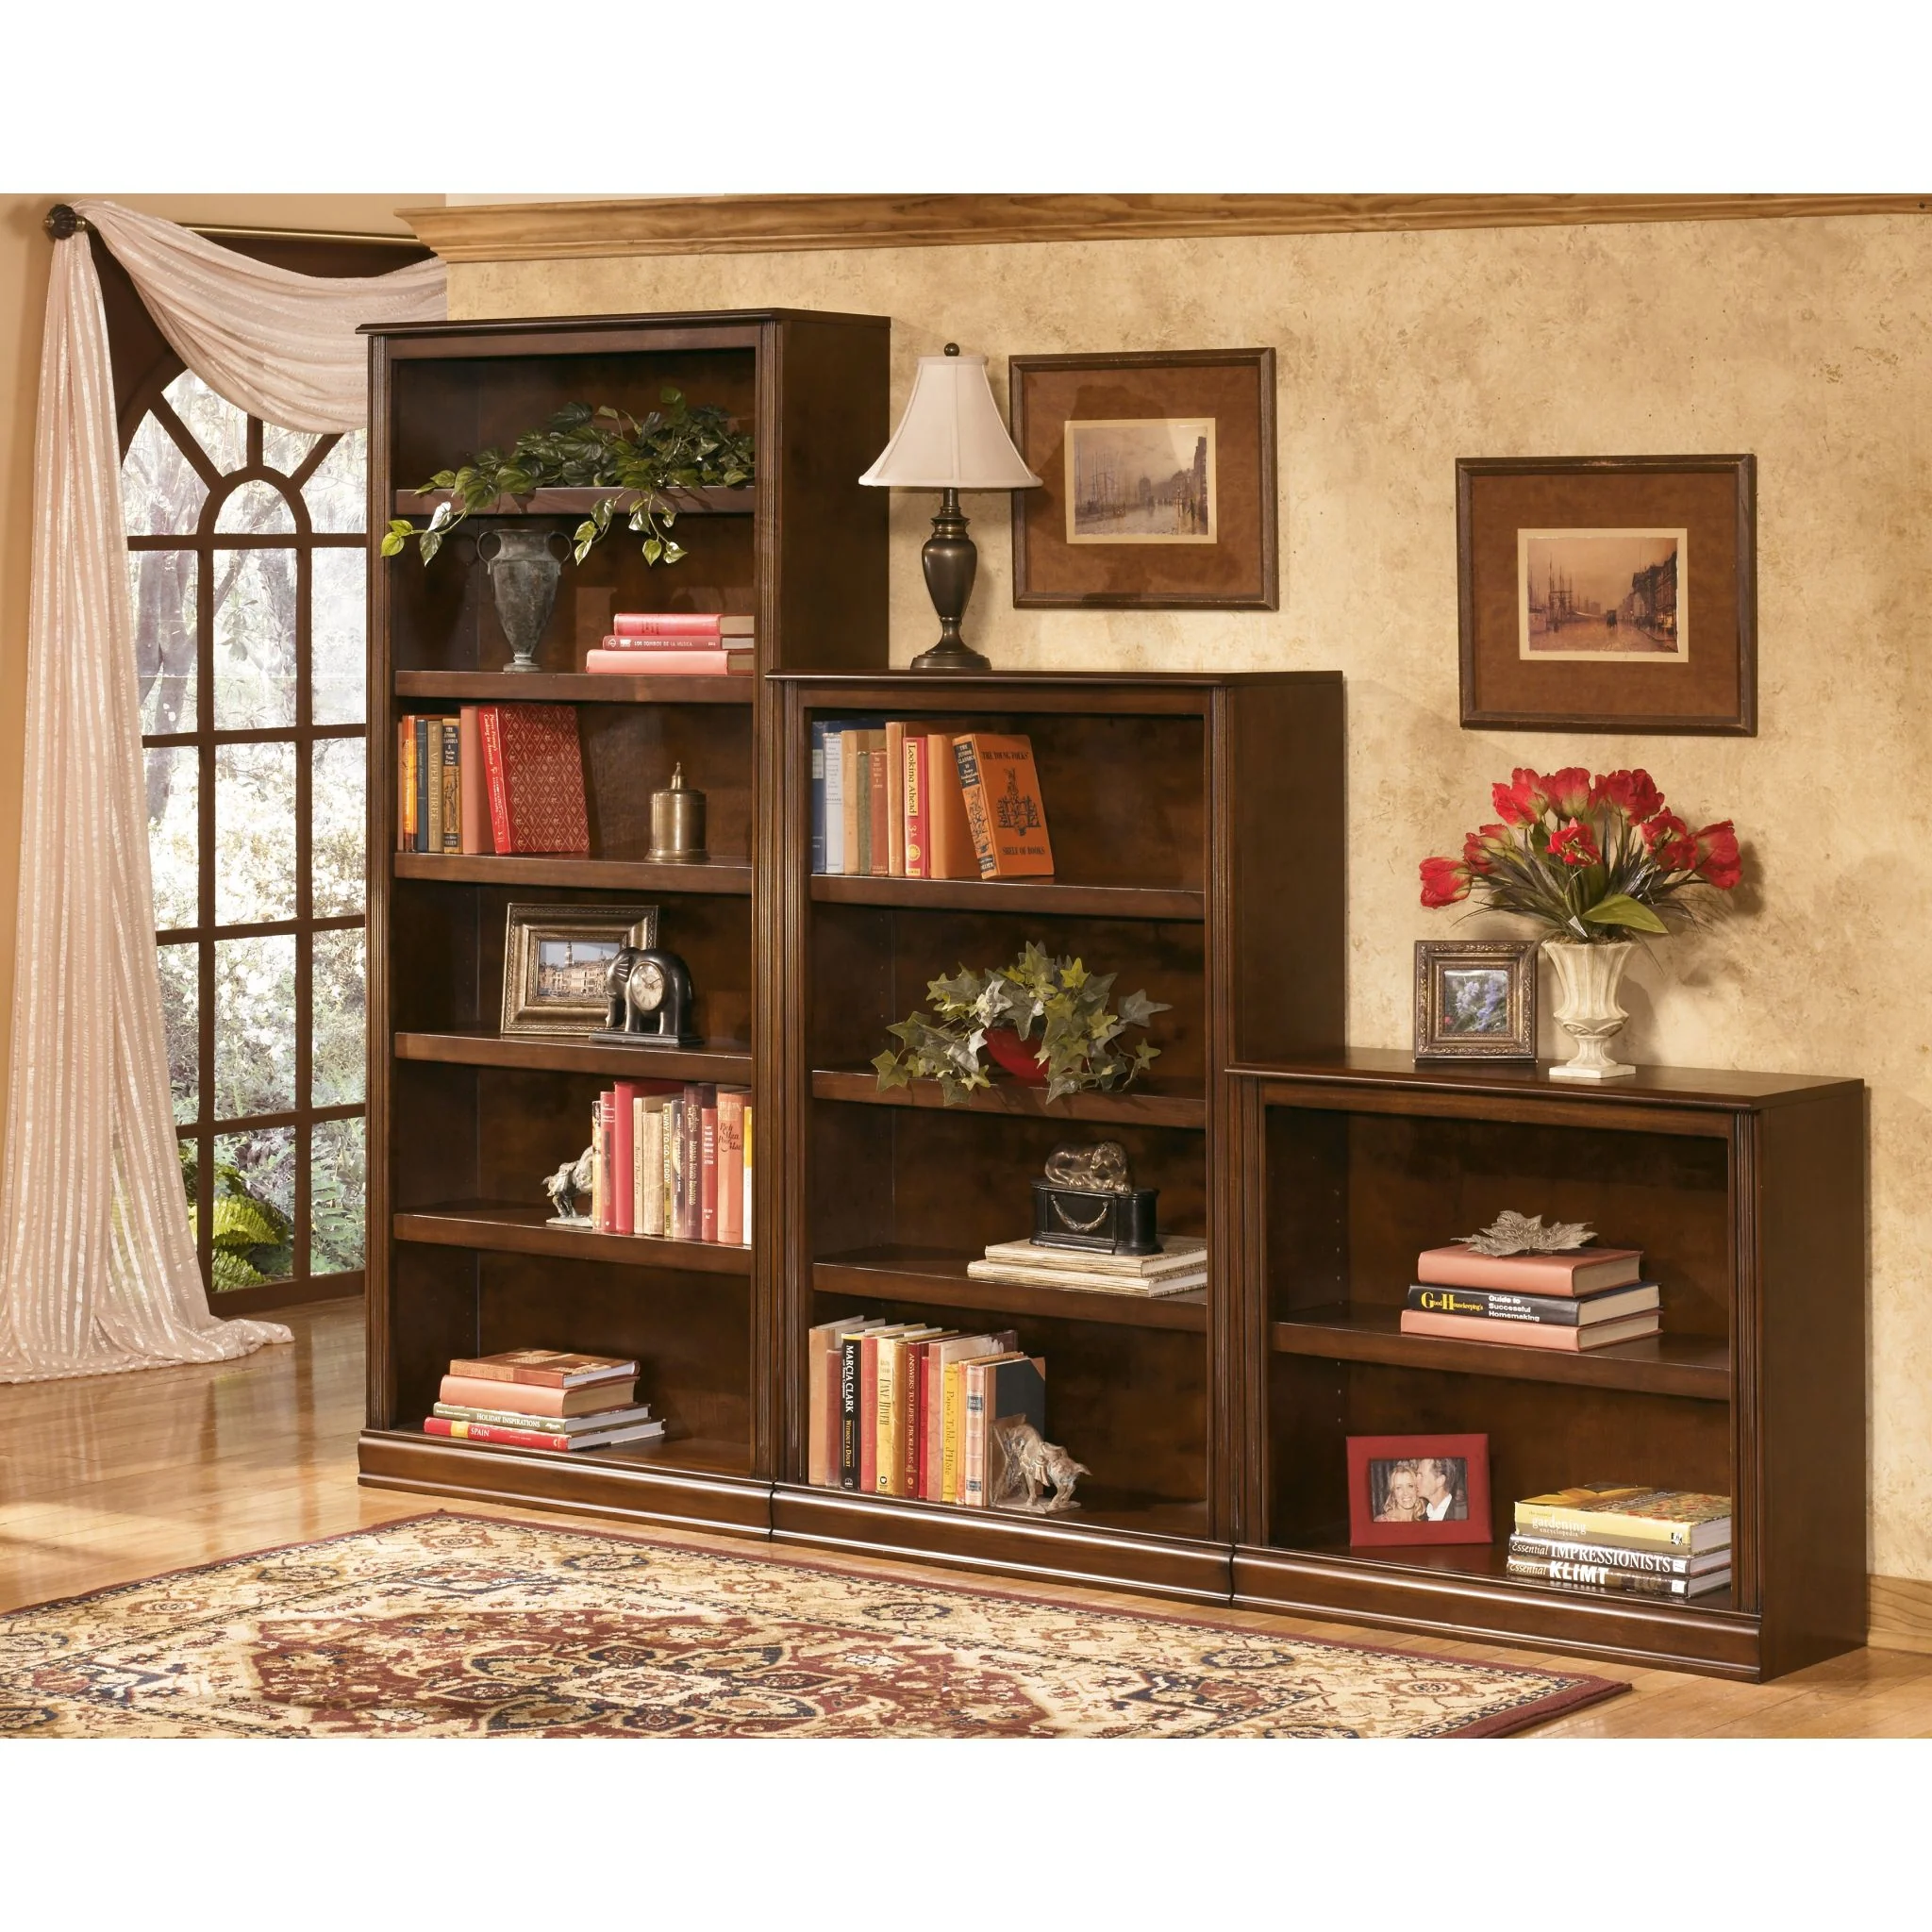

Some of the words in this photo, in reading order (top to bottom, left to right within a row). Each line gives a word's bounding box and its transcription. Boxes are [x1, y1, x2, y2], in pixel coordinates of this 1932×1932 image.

[430, 752, 439, 783] VIPER
[430, 786, 439, 821] THREE
[908, 785, 917, 813] Ahead
[664, 1134, 670, 1143] TO
[1489, 1294, 1511, 1304] Guide
[1489, 1302, 1531, 1313] Successful
[1489, 1310, 1540, 1322] Homemaking
[845, 1345, 854, 1381] MARCIA
[845, 1383, 854, 1412] CLARK
[879, 1379, 891, 1398] CANE
[908, 1392, 914, 1402] TO
[476, 1413, 502, 1423] HOLIDAY
[502, 1416, 541, 1427] INSPIRATIONS
[879, 1402, 891, 1424] RIVER
[945, 1419, 955, 1443] Table
[1532, 1515, 1586, 1535] gardening
[1540, 1528, 1578, 1537] encyclopedia
[1512, 1541, 1548, 1556] Essential
[1551, 1543, 1671, 1573] IMPRESSIONISTS
[1510, 1563, 1547, 1575] Essential
[1549, 1560, 1608, 1585] KLIMT
